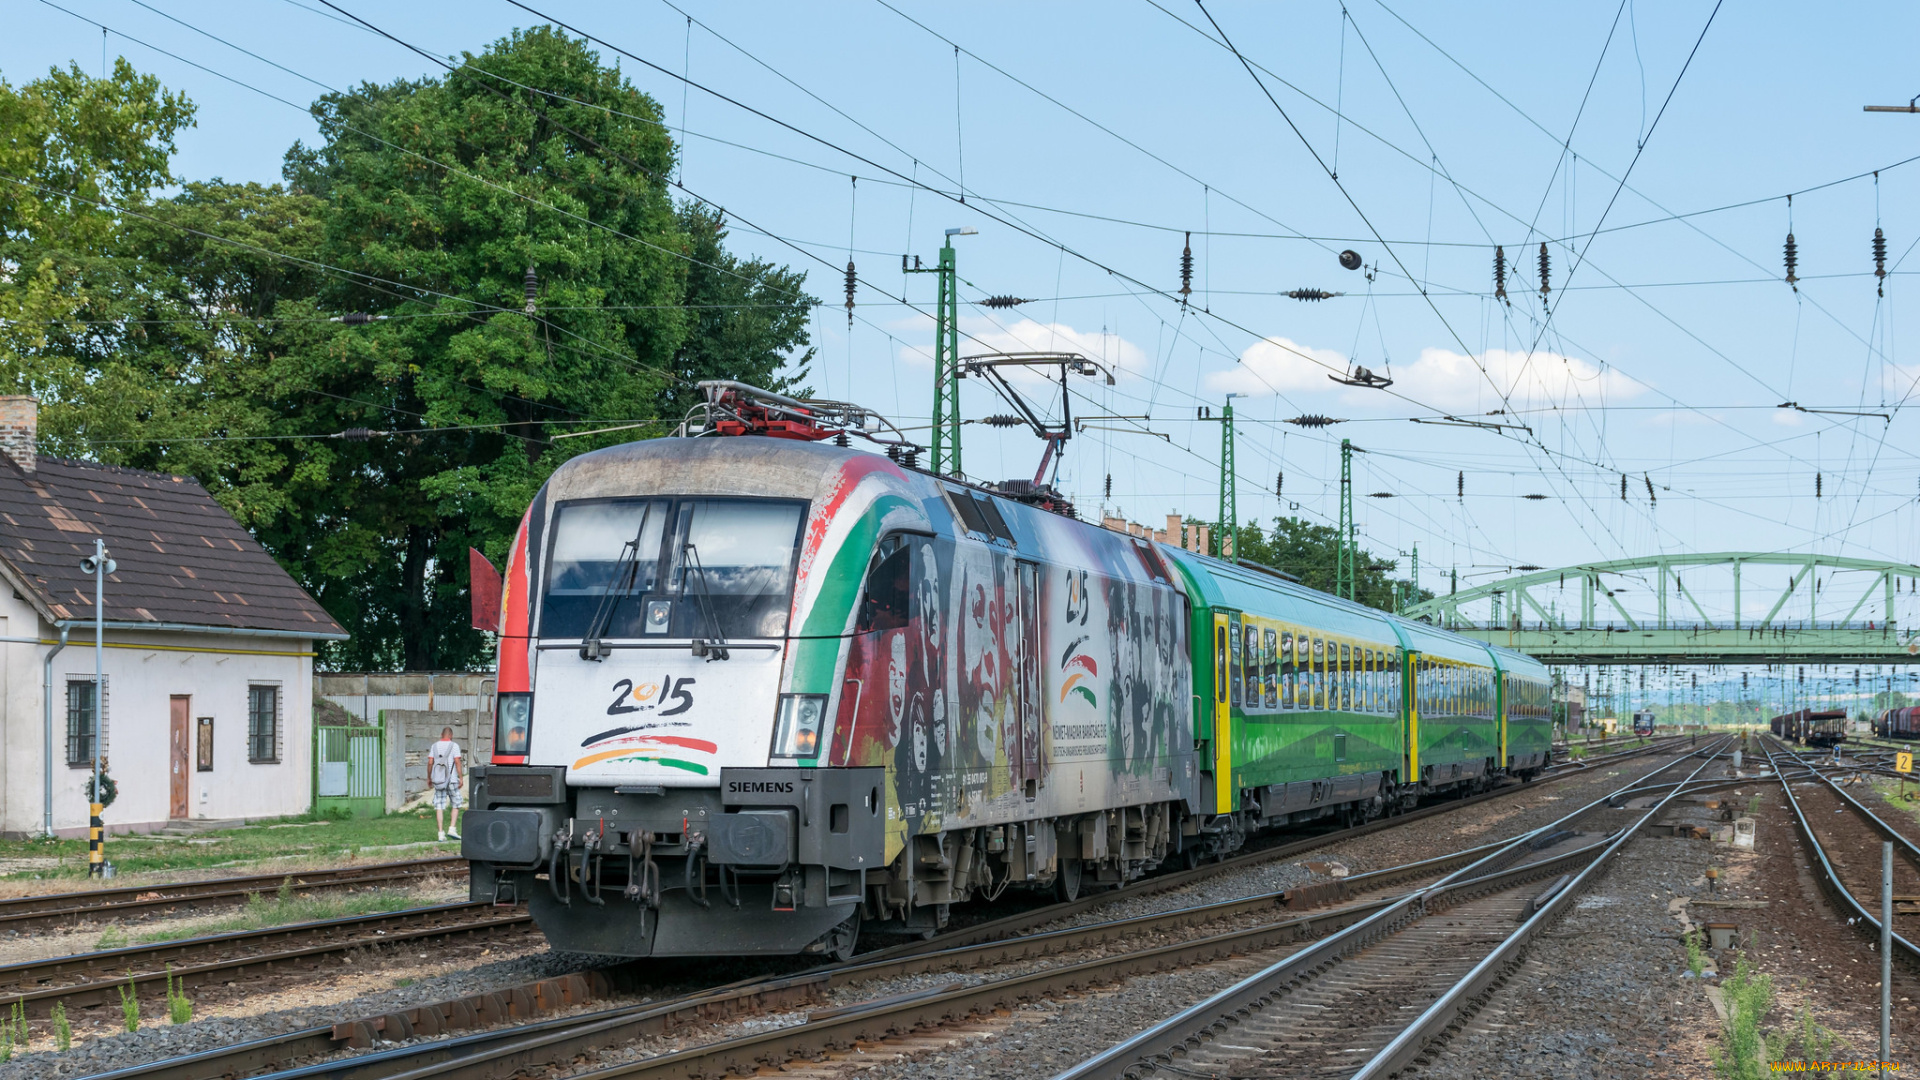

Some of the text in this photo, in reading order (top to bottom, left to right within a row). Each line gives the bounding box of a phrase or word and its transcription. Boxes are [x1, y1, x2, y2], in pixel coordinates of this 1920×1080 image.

[1066, 569, 1089, 626] 2015
[607, 674, 696, 716] 2015
[1900, 755, 1908, 770] 2
[729, 781, 794, 793] SIEMENS
